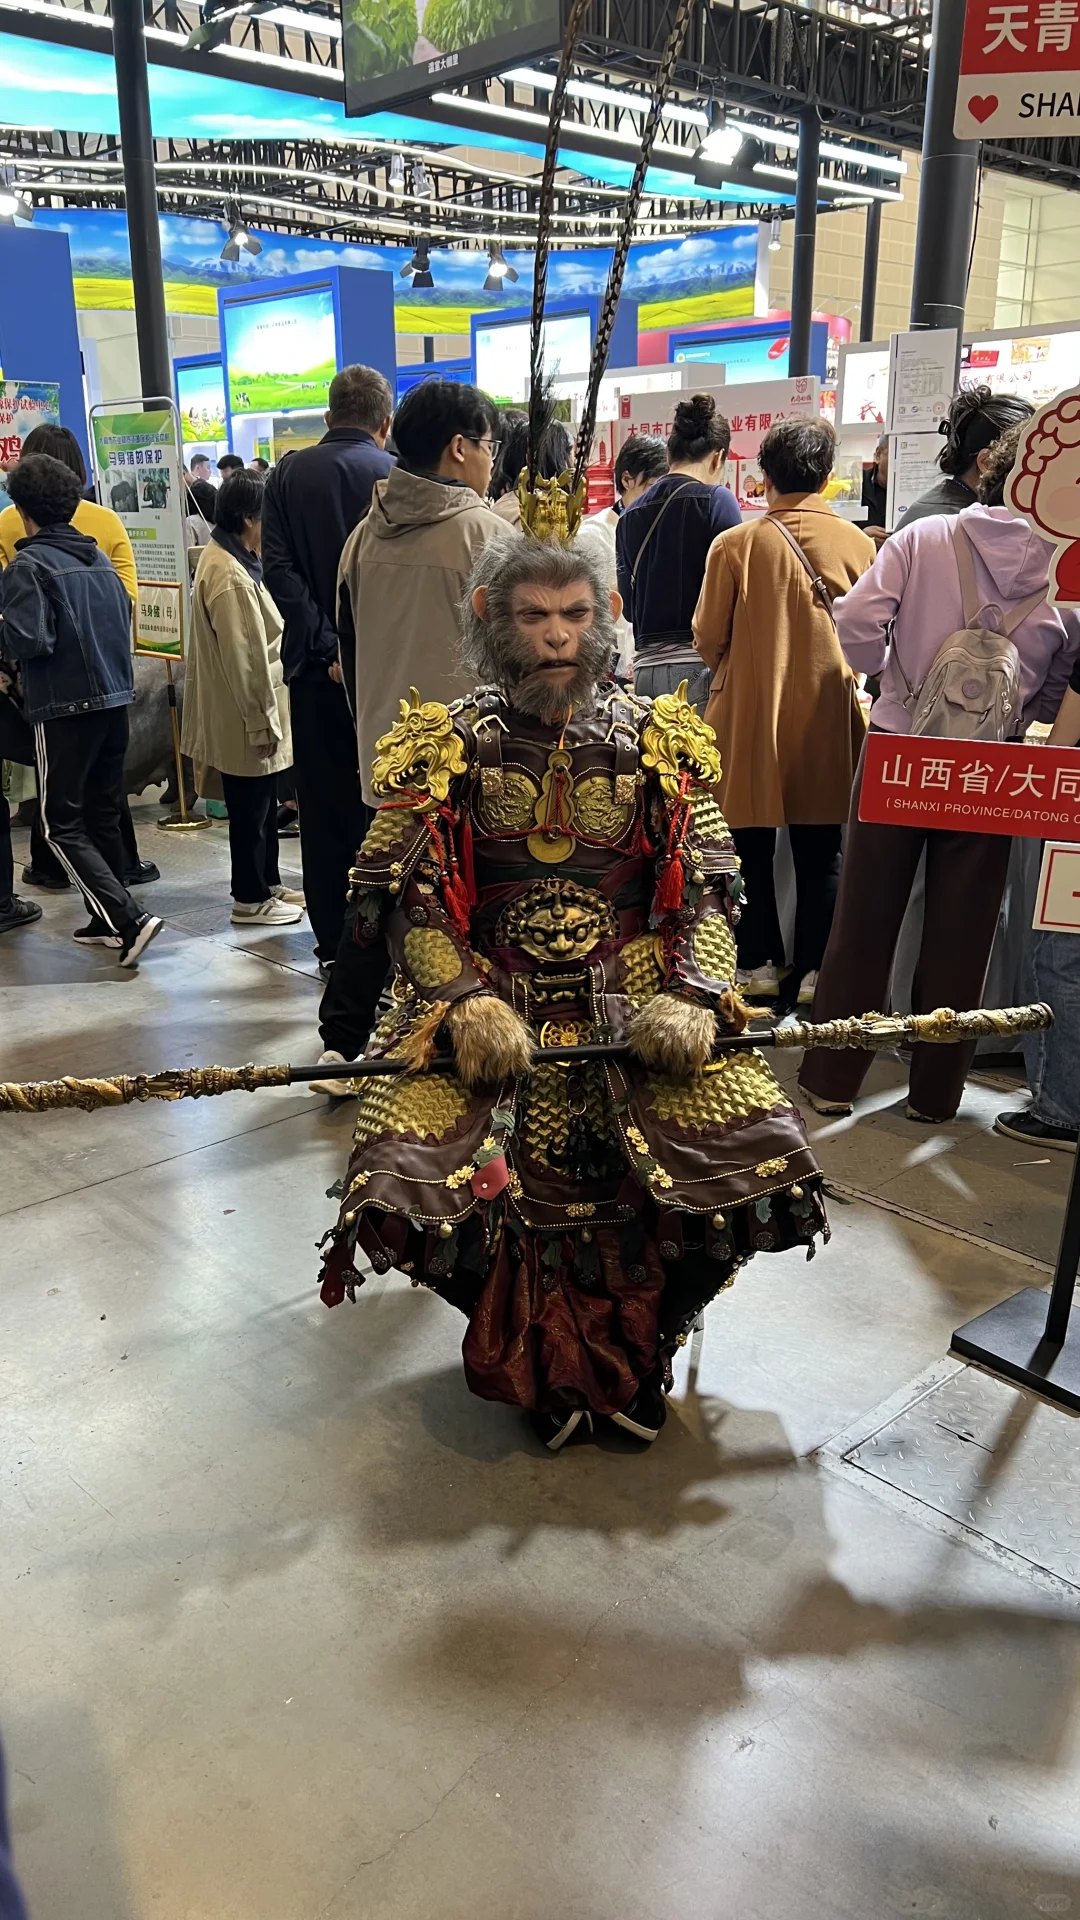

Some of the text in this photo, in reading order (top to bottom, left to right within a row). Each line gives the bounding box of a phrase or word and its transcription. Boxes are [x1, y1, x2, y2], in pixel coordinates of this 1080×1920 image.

[982, 0, 1079, 55] 天青
[1018, 91, 1080, 119] SHA
[881, 754, 1080, 803] 山西省/大同
[944, 803, 1070, 823] PROVINCE/DATONG
